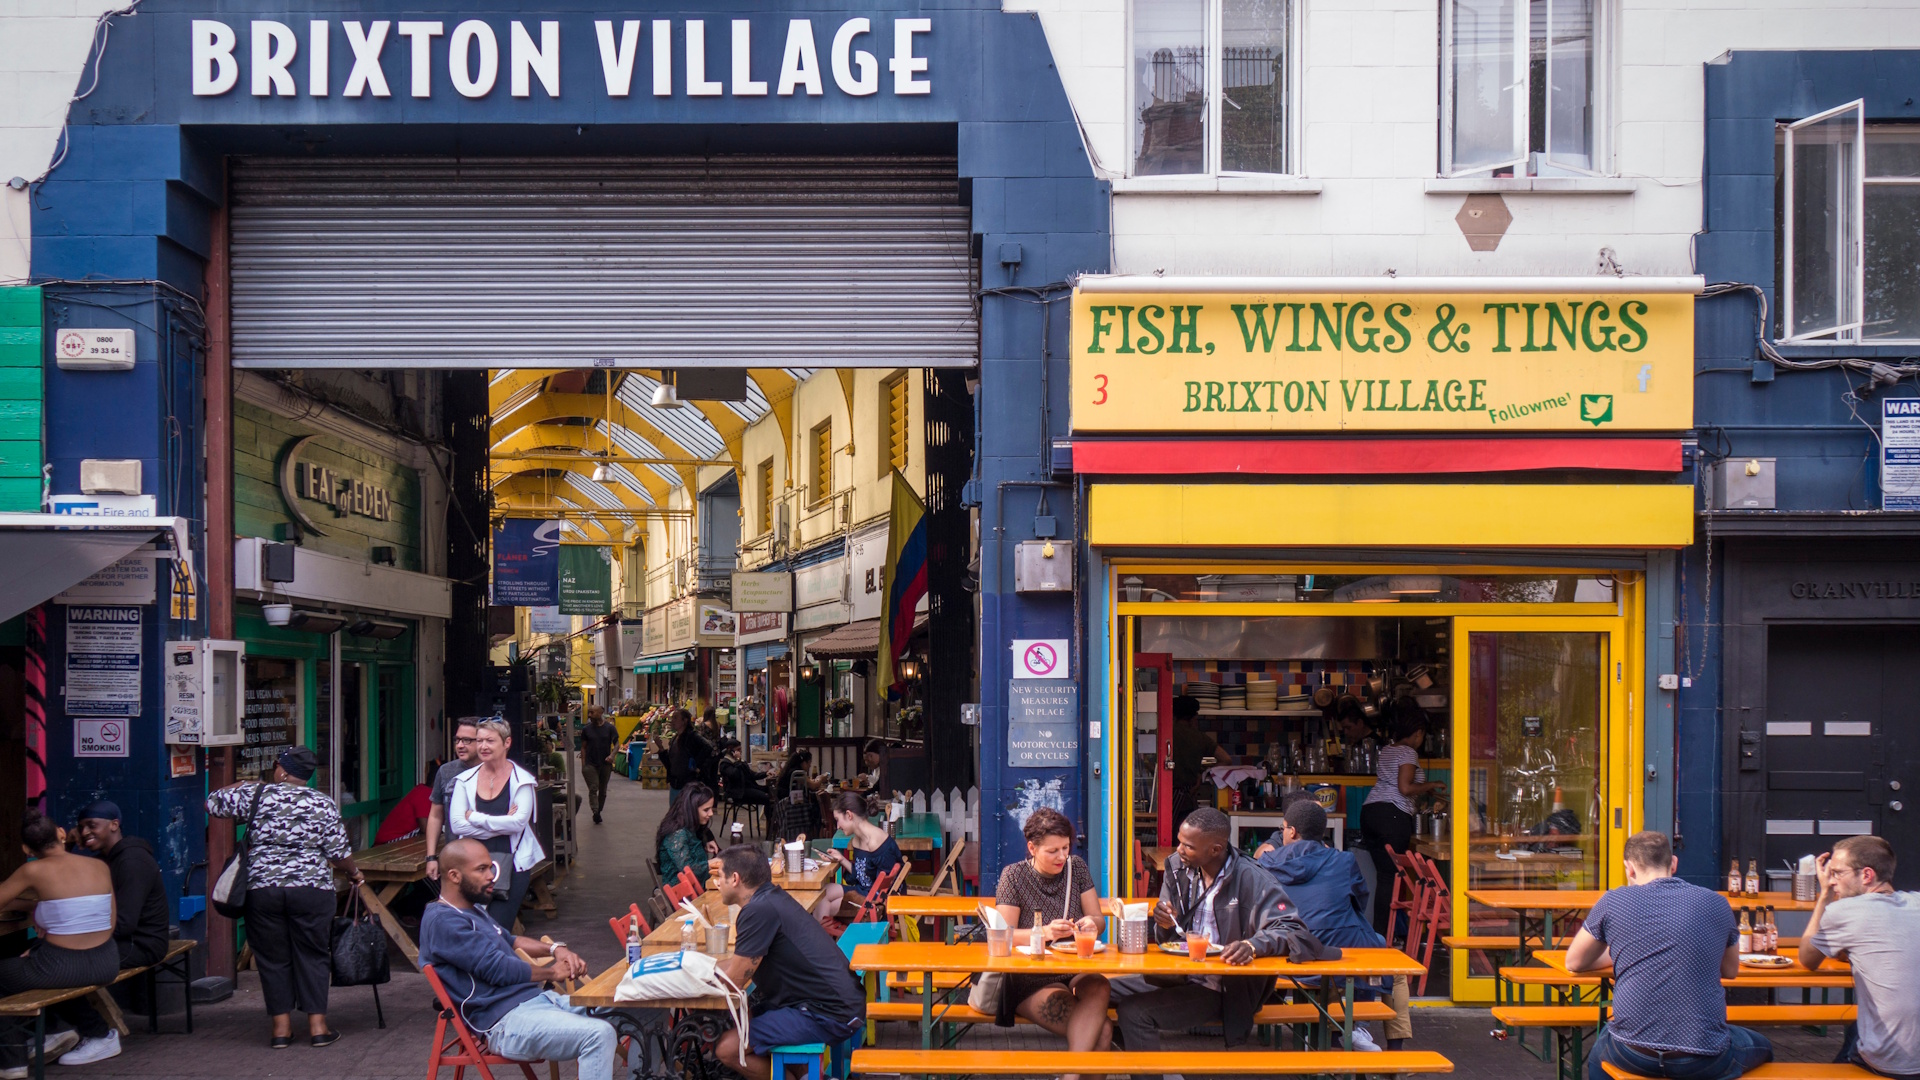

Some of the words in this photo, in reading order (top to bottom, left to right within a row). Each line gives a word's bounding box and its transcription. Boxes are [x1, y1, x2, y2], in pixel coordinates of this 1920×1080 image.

[192, 19, 561, 97] BRIXTON
[595, 18, 932, 97] VILLAGE
[1087, 304, 1217, 356] FISH,
[1231, 301, 1412, 354] WINGS
[1427, 302, 1471, 354] &
[1484, 300, 1649, 354] TINGS
[1092, 374, 1109, 406] 3
[1183, 380, 1331, 413] BRIXTON
[1340, 380, 1488, 413] VILLAGE
[350, 479, 392, 522] EDEN
[741, 579, 760, 587] Herbs
[740, 597, 769, 605] Massage
[70, 608, 139, 621] WARNING
[1012, 686, 1033, 694] NEW
[1034, 686, 1078, 694] SECURITY
[1021, 697, 1069, 705] MEASURES
[1025, 708, 1035, 716] IN
[1036, 708, 1065, 716] PLACE
[81, 744, 121, 752] SMOKING
[1012, 741, 1078, 749] MOTORCYCLES
[1020, 752, 1033, 760] OR
[1035, 752, 1070, 760] CYCLES
